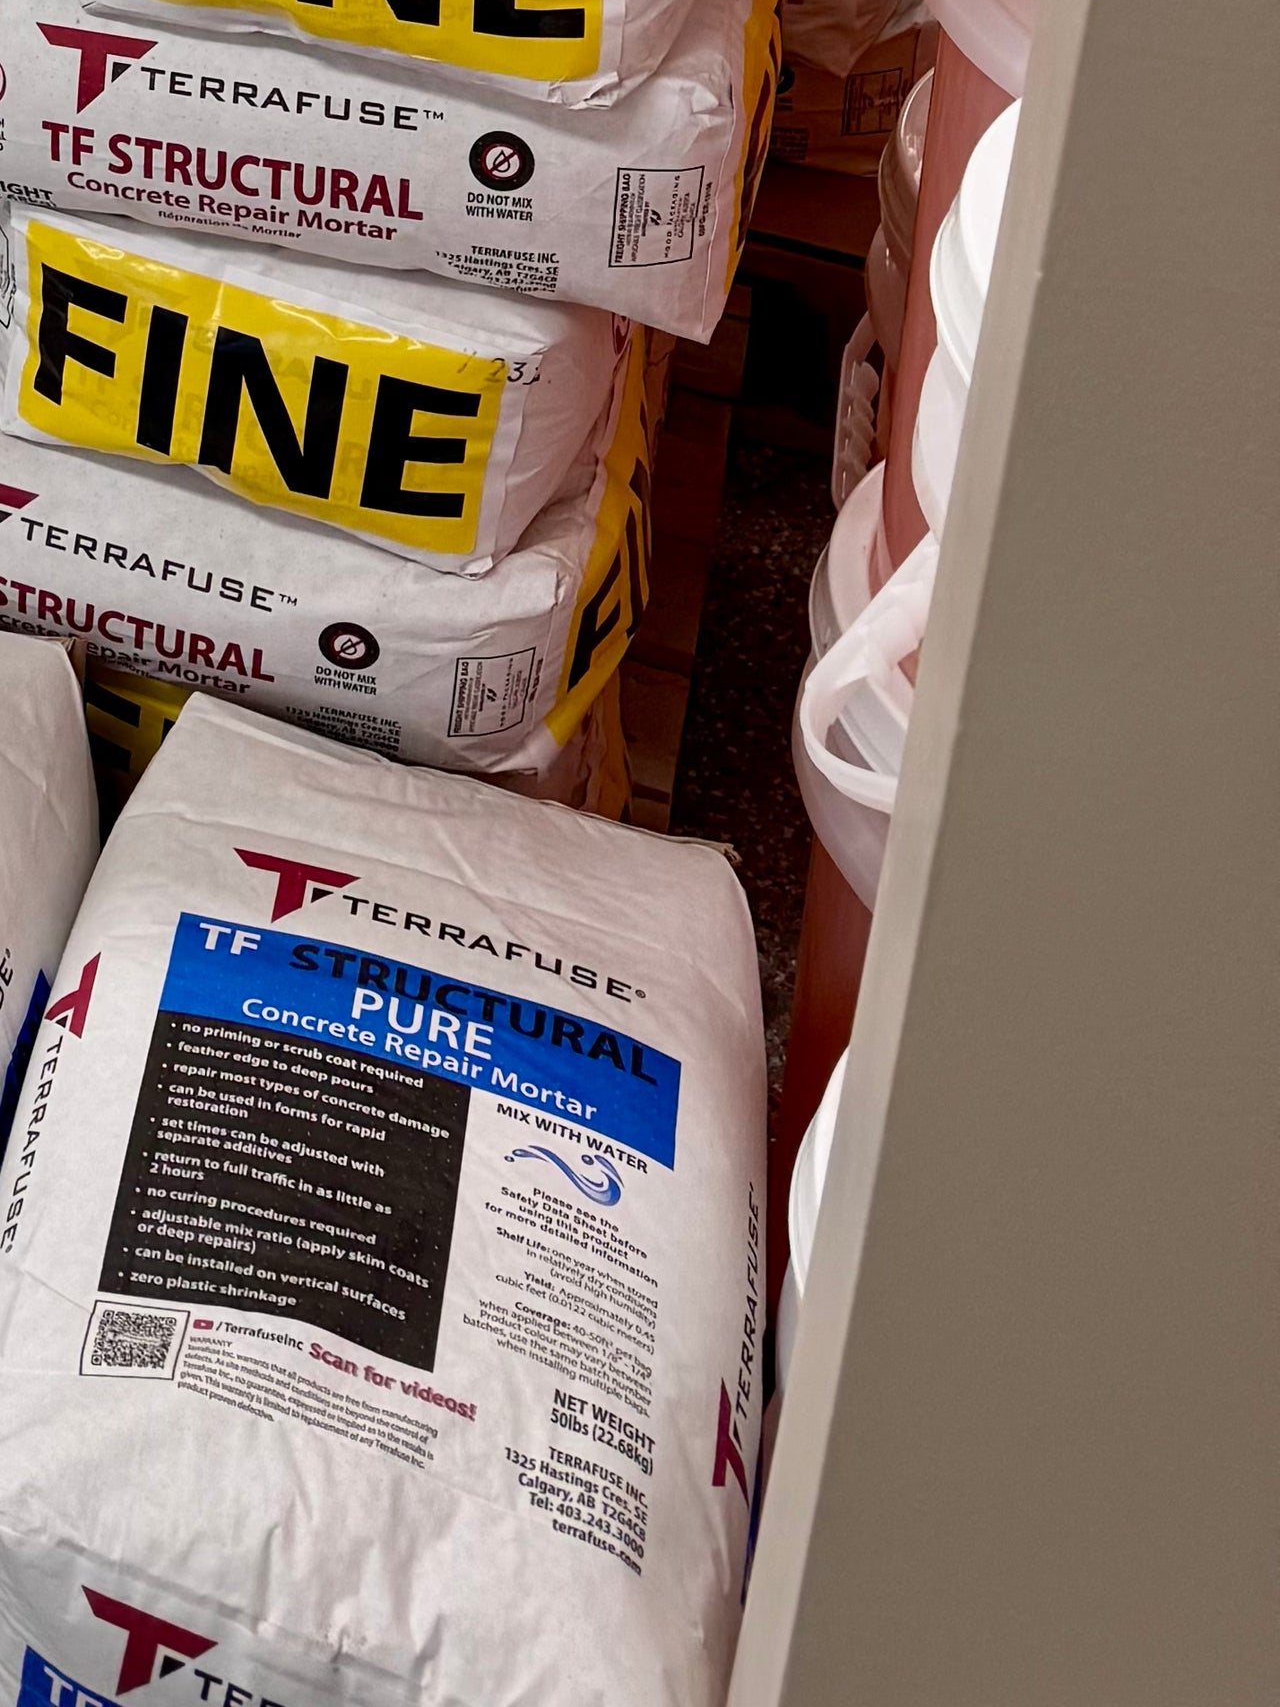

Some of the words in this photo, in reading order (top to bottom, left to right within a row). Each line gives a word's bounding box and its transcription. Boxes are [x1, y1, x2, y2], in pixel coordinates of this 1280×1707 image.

[143, 66, 420, 133] TERRAFUSE
[41, 122, 96, 166] TF
[106, 132, 424, 222] STRUCTURAL
[32, 262, 482, 522] FINE
[342, 895, 634, 1004] TERRAFUSE
[198, 922, 262, 956] TF
[288, 943, 661, 1087] STRUCTURAL
[351, 988, 494, 1060] PURE
[178, 1041, 230, 1060] feather
[233, 1051, 270, 1069] edge
[272, 1060, 288, 1071] to
[291, 1065, 328, 1082] deep
[331, 1074, 374, 1093] pours
[182, 1023, 201, 1033] no
[204, 1026, 261, 1048] priming
[264, 1040, 280, 1050] or
[283, 1044, 322, 1061] scrub
[326, 1053, 357, 1070] coat
[360, 1061, 424, 1088] required
[240, 996, 376, 1047] Concrete
[383, 1032, 485, 1079] Repair
[490, 1066, 599, 1122] Mortar
[173, 1062, 218, 1080] repair
[220, 1069, 257, 1086] most
[260, 1076, 300, 1095] types
[304, 1088, 320, 1099] of
[322, 1091, 386, 1119] concrete
[388, 1111, 450, 1139] damage
[496, 1102, 533, 1127] MIX
[536, 1114, 584, 1145] WITH
[586, 1136, 649, 1176] WATER
[130, 1271, 163, 1286] zero
[166, 1276, 217, 1293] plastic
[219, 1285, 297, 1306] shrinkage
[309, 1342, 360, 1376] Scan
[363, 1362, 398, 1388] for
[401, 1377, 478, 1421] videos!
[550, 1408, 589, 1435] 50lbs
[592, 1424, 653, 1476] (22.68kg)
[554, 1388, 588, 1415] NET
[592, 1404, 656, 1454] WEIGHT
[505, 1447, 536, 1470] 1325
[540, 1460, 599, 1493] Hastings
[634, 1505, 648, 1526] SE
[518, 1473, 574, 1503] Calgary,
[577, 1495, 596, 1509] AB
[549, 1446, 623, 1489] TERRAFUSE
[529, 1492, 554, 1511] Tel:
[556, 1503, 644, 1559] 403.243.3000
[552, 1519, 642, 1576] terrafuse.com
